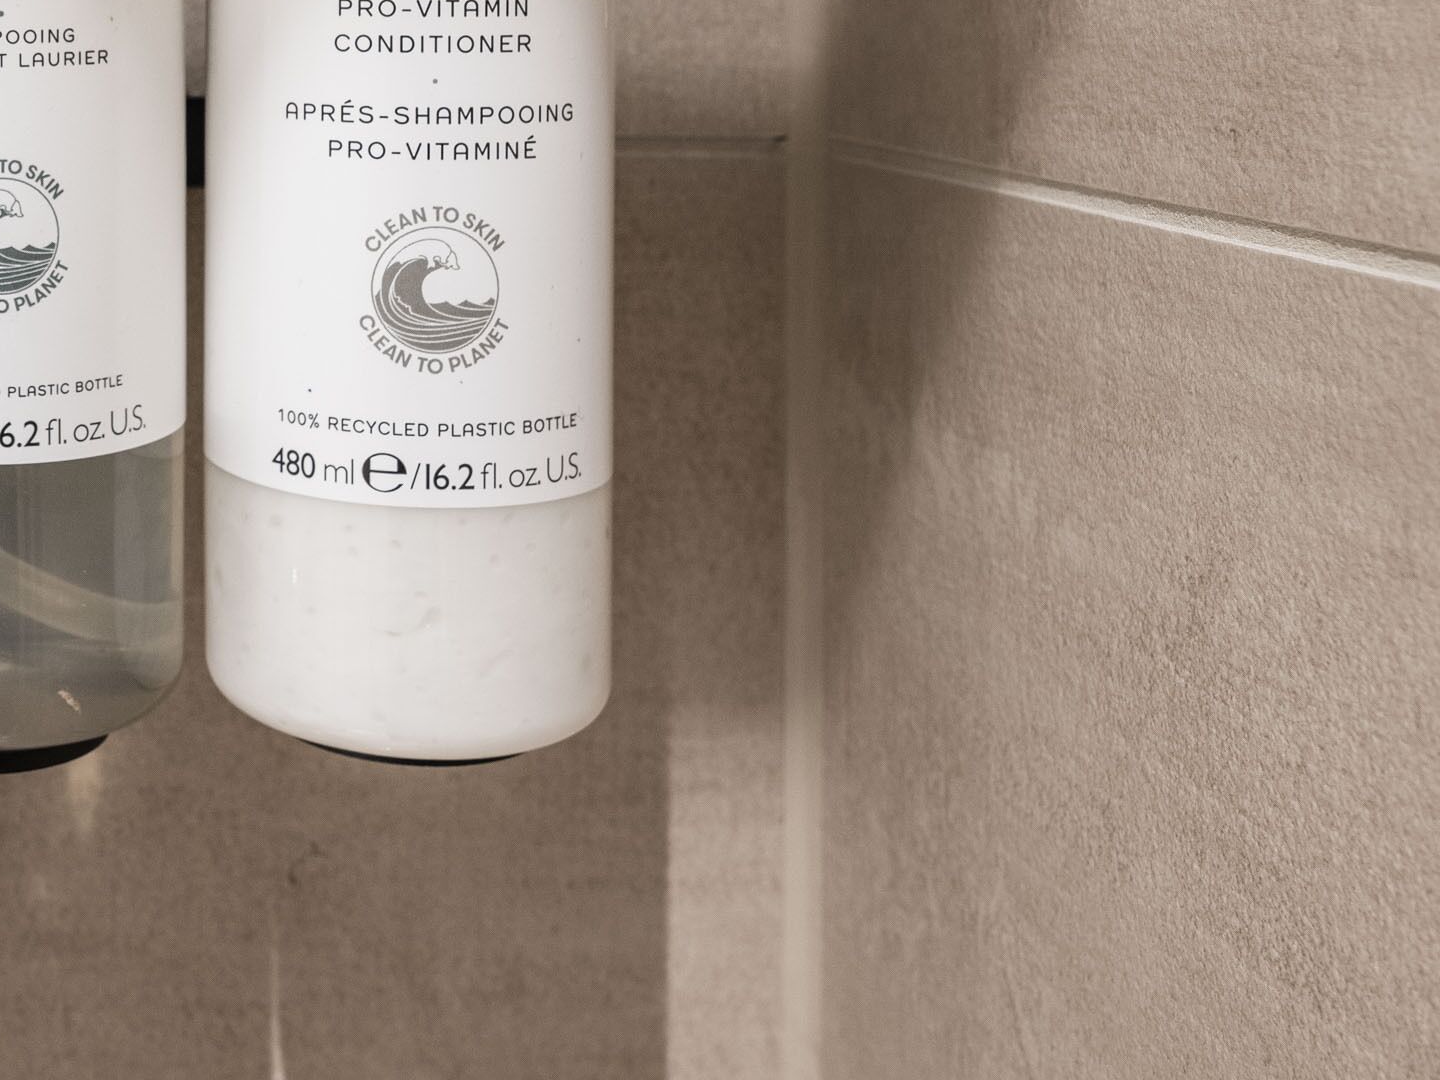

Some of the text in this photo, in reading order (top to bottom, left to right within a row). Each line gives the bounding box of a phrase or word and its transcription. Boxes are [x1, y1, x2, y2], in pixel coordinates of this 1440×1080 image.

[18, 50, 109, 68] LAURIER
[334, 34, 532, 54] CONDITIONER
[285, 99, 574, 125] APRÉS-SHAMPOOING
[328, 135, 537, 161] PRO-VITAMINÉ
[25, 165, 65, 201] SKIN
[364, 206, 506, 253] CLEAN TO SKIN
[14, 259, 69, 312] PLANET
[359, 314, 510, 375] CLEAN TO PLANET
[8, 382, 70, 398] PLASTIC
[75, 374, 124, 393] BOTTLE
[46, 418, 67, 445] fl.
[73, 421, 105, 442] oz.
[110, 403, 147, 436] U.S.
[278, 408, 578, 438] 100% RECYCLED PLASTIC BOTTLE
[271, 447, 316, 479] 480
[480, 461, 503, 490] fl.
[509, 466, 541, 488] oz.
[546, 452, 582, 484] U.S.
